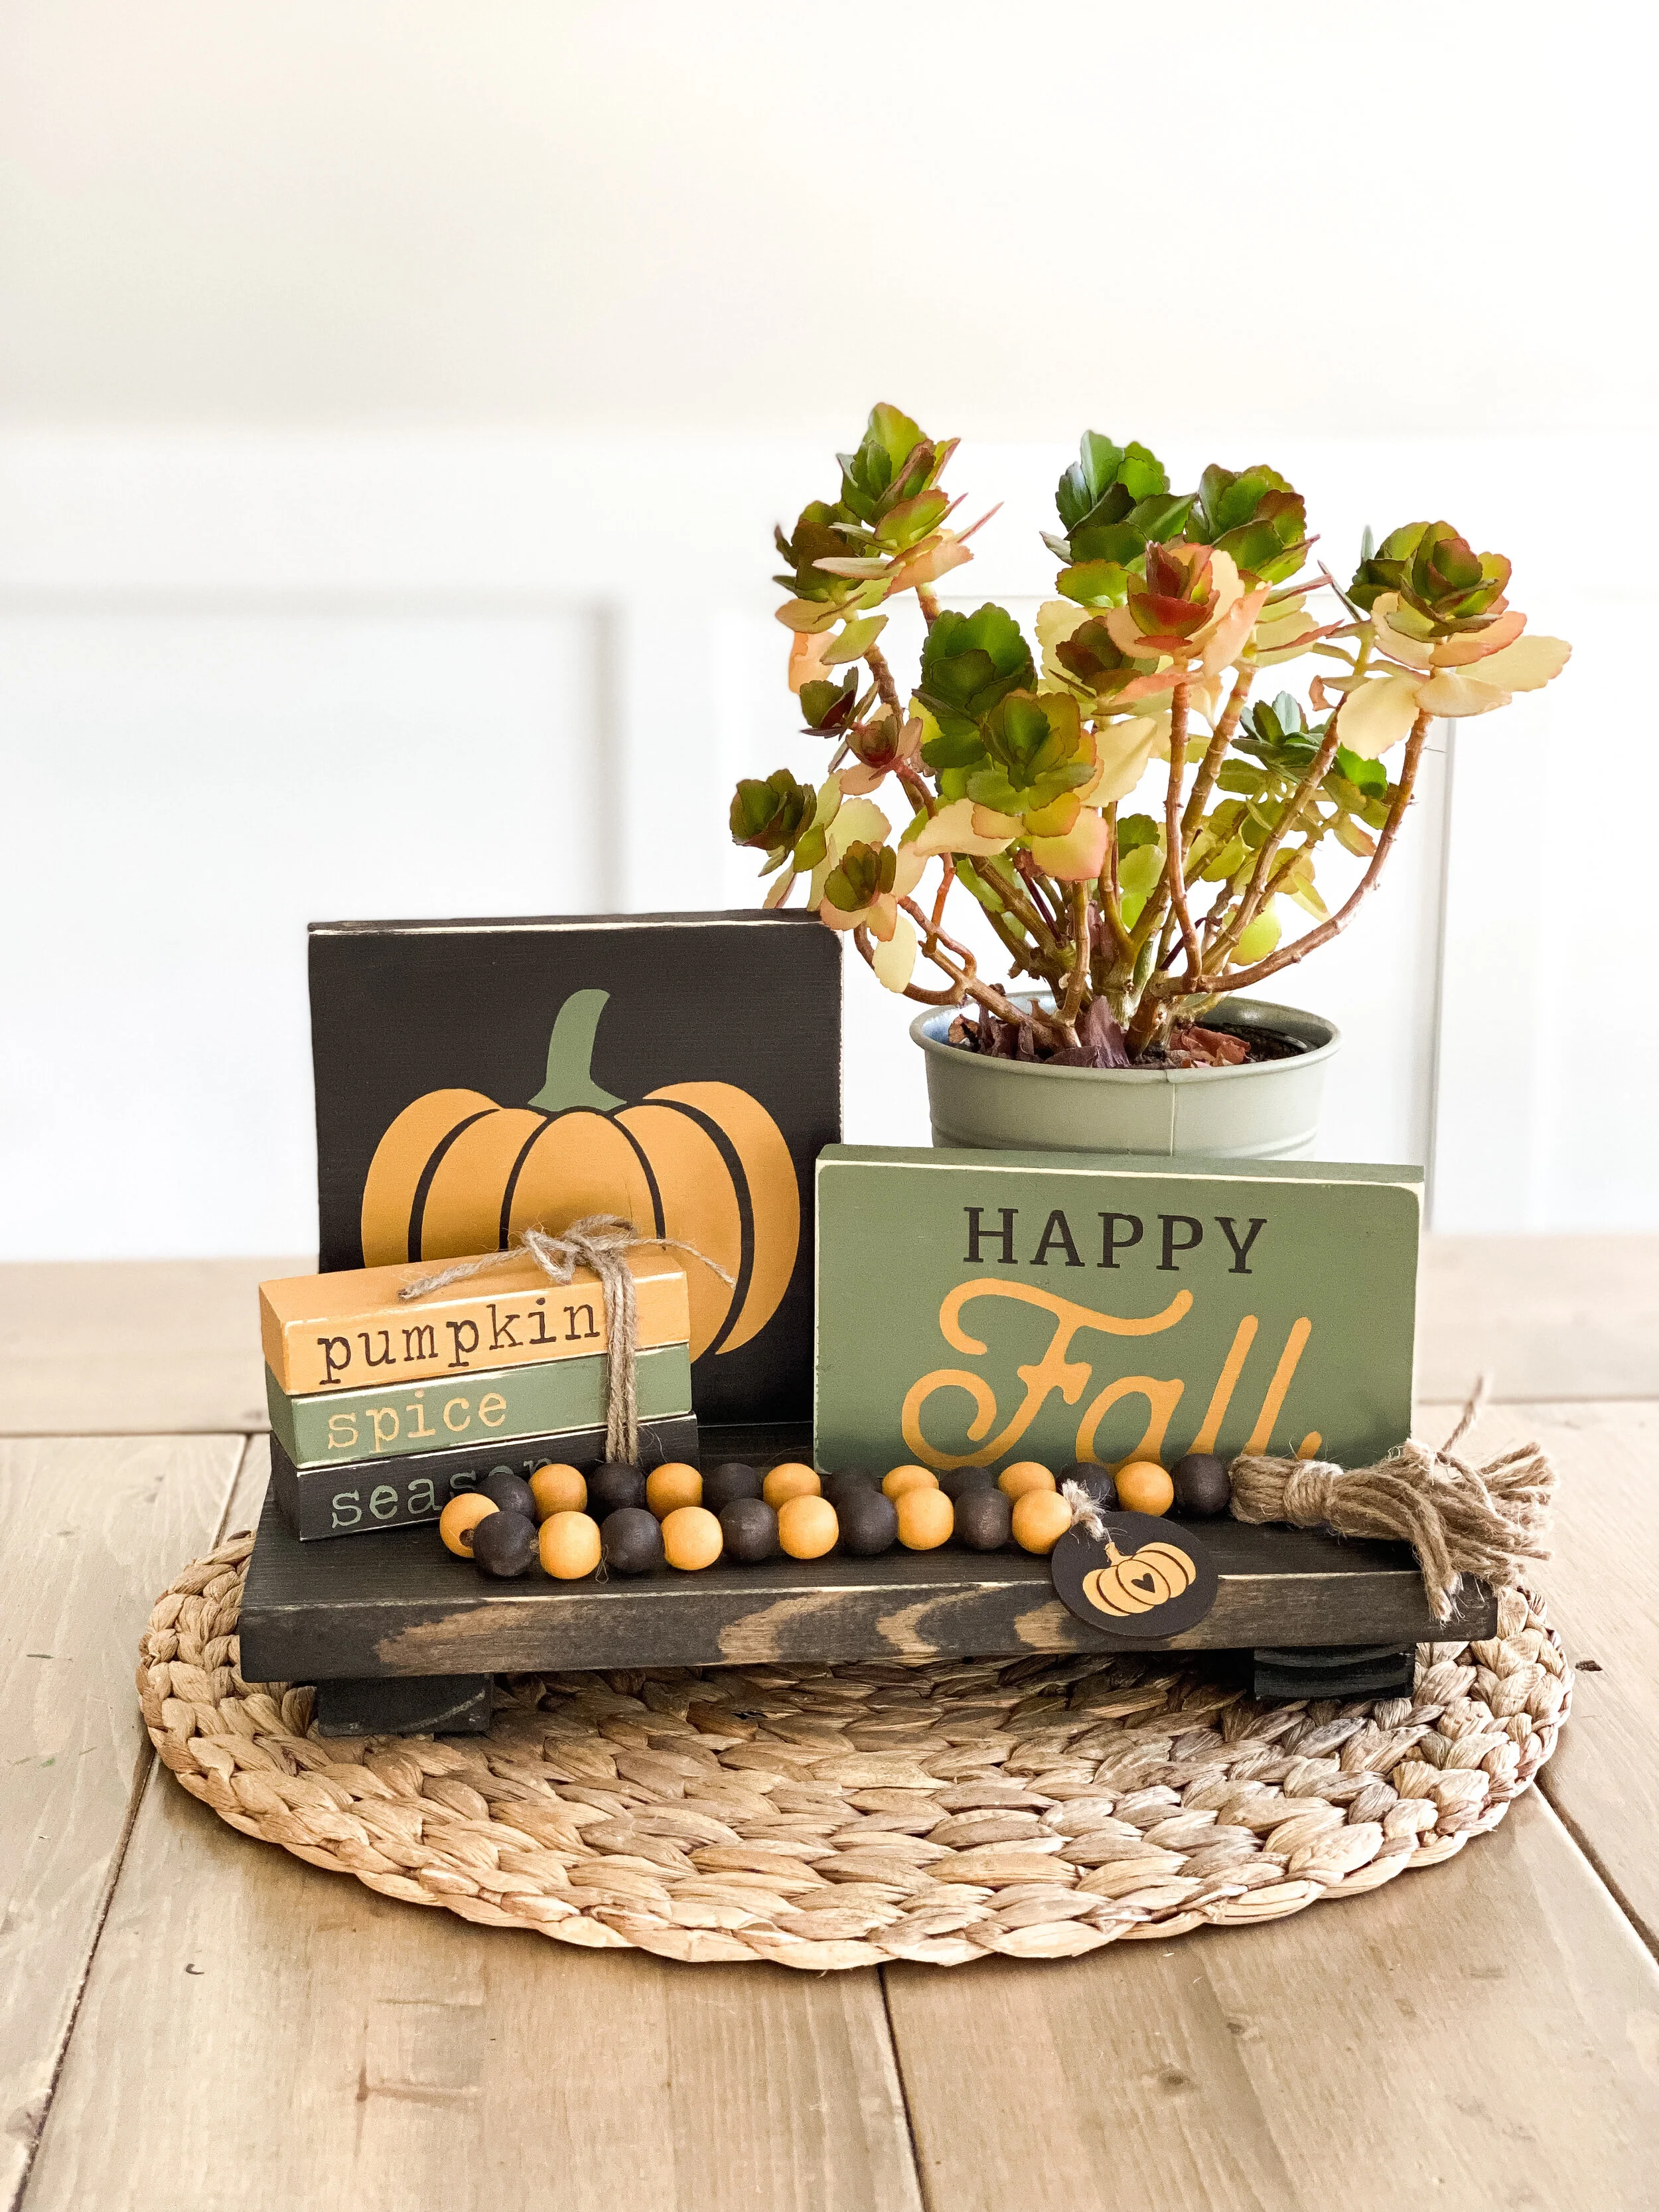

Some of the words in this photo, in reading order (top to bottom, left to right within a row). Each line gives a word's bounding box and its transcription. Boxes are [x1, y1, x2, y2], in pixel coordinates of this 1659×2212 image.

[962, 1206, 1268, 1274] HAPPY
[317, 1297, 601, 1385] pumpkin
[901, 1278, 1322, 1472] Fall
[327, 1389, 508, 1452] spice
[331, 1457, 552, 1528] seas
